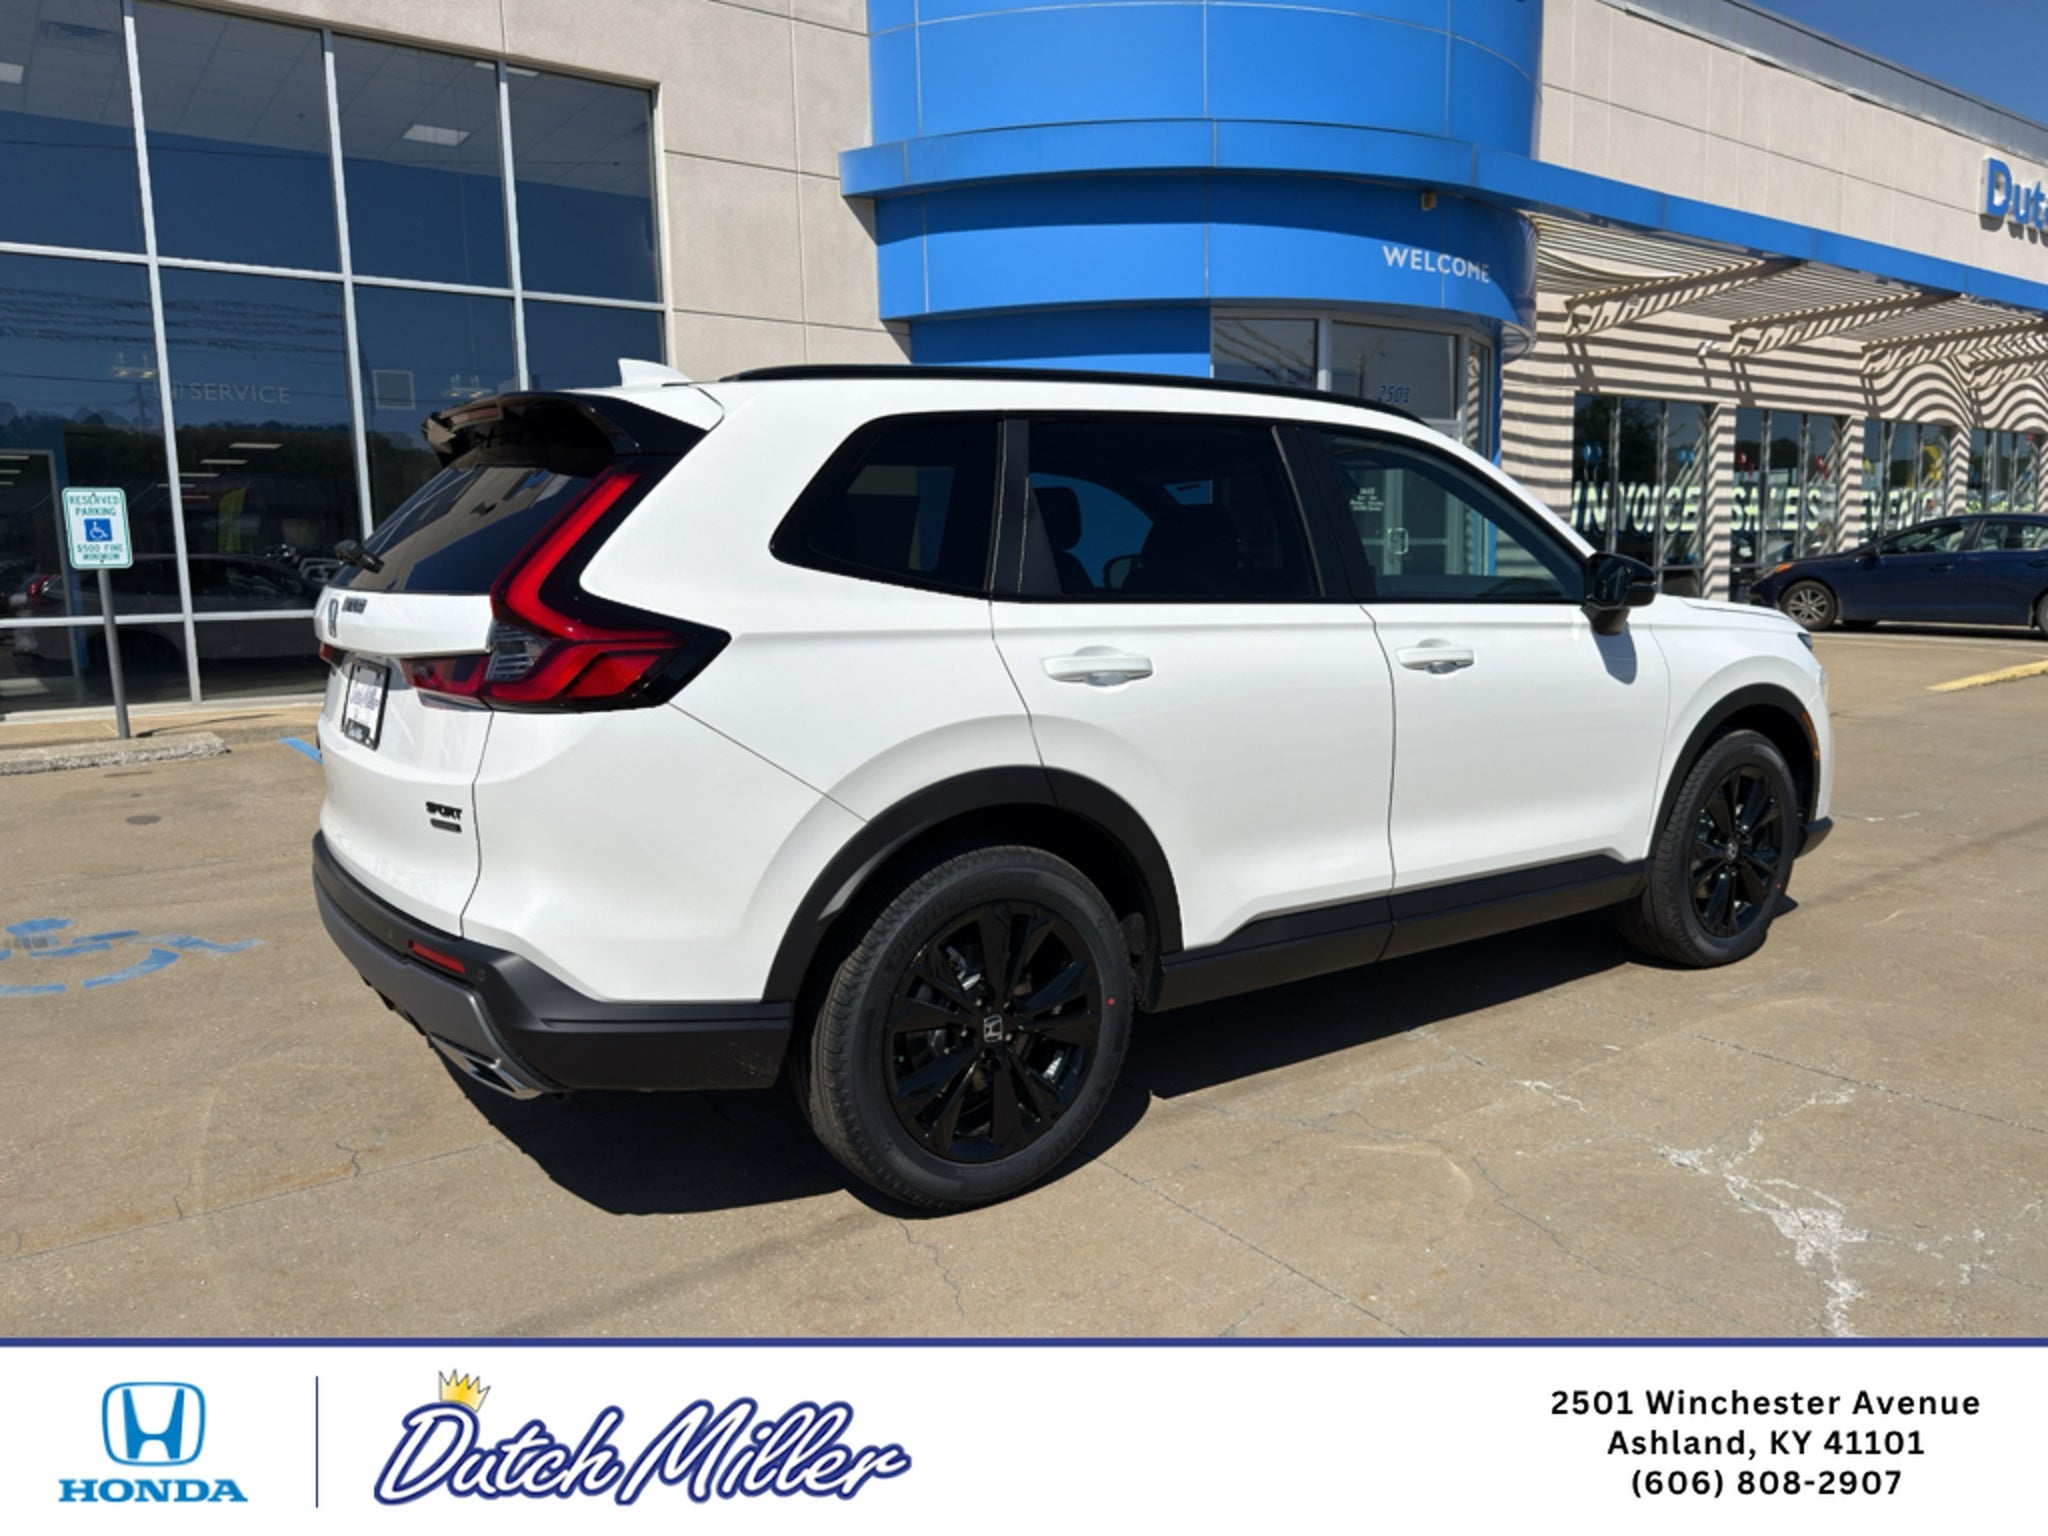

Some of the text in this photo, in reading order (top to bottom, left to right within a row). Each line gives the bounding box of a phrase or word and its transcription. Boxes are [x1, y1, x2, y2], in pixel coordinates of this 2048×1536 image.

[1984, 158, 2048, 230] Dut
[1382, 244, 1491, 284] WELCOME
[190, 382, 292, 405] SERVICE
[1376, 384, 1411, 405] 2501
[69, 495, 119, 505] RESERVED
[1571, 481, 1701, 532] INVOICE
[1730, 486, 1821, 531] SALES
[75, 507, 116, 517] PARKING
[425, 801, 463, 820] SPORT
